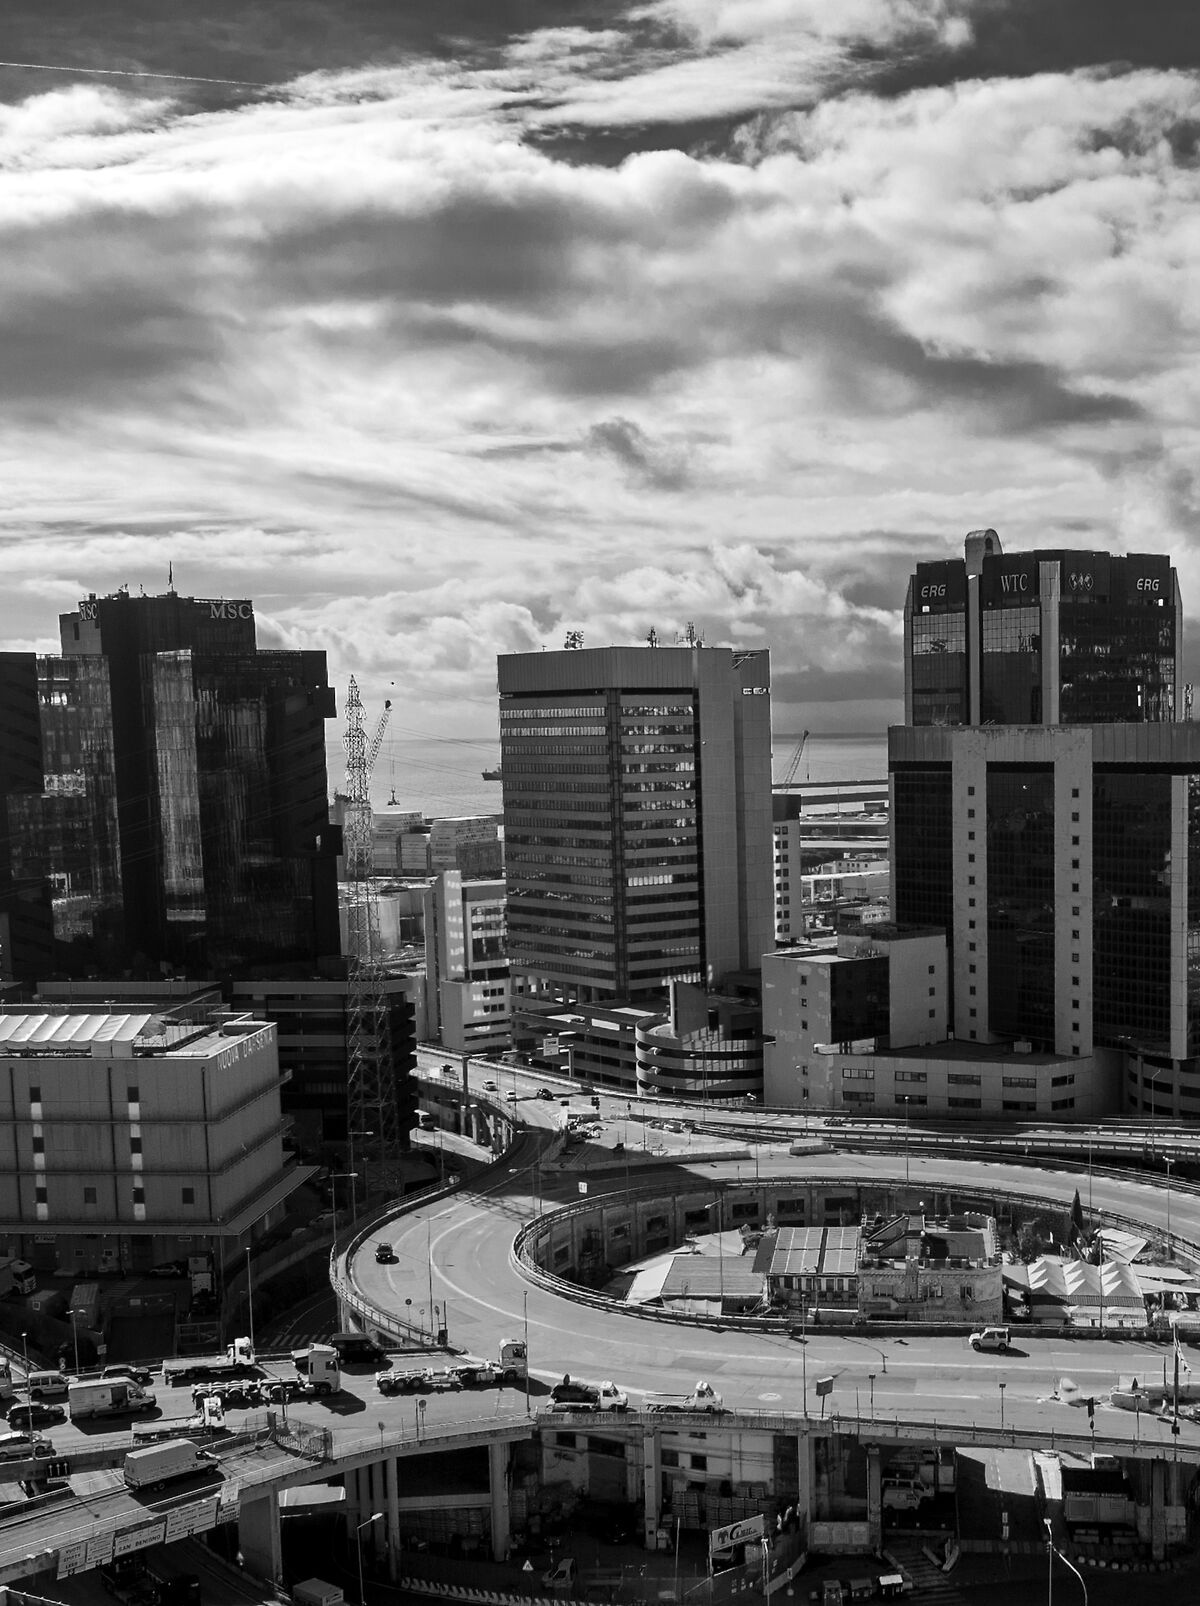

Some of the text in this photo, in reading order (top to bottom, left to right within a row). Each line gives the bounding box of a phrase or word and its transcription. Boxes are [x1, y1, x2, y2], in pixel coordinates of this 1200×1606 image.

[921, 584, 947, 598] ERG
[1000, 574, 1028, 593] WTC
[1136, 578, 1160, 591] ERG
[209, 603, 251, 619] MSC
